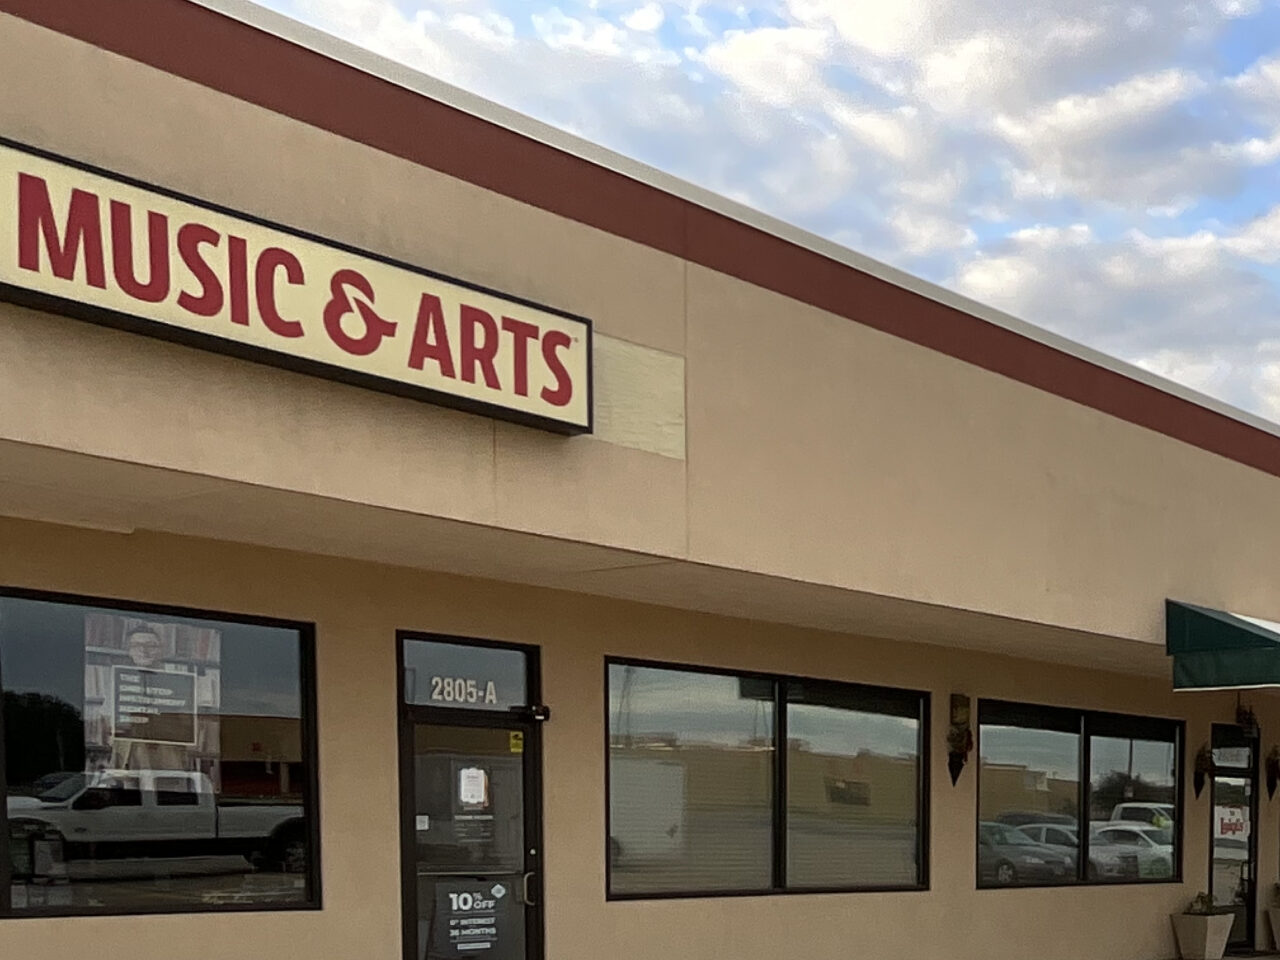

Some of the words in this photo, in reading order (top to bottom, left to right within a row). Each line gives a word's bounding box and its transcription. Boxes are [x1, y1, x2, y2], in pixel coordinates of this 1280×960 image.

[18, 171, 305, 338] MUSIC
[322, 268, 398, 356] &
[408, 292, 574, 406] ARTS
[431, 676, 497, 704] 2805-A
[473, 900, 496, 909] OFF
